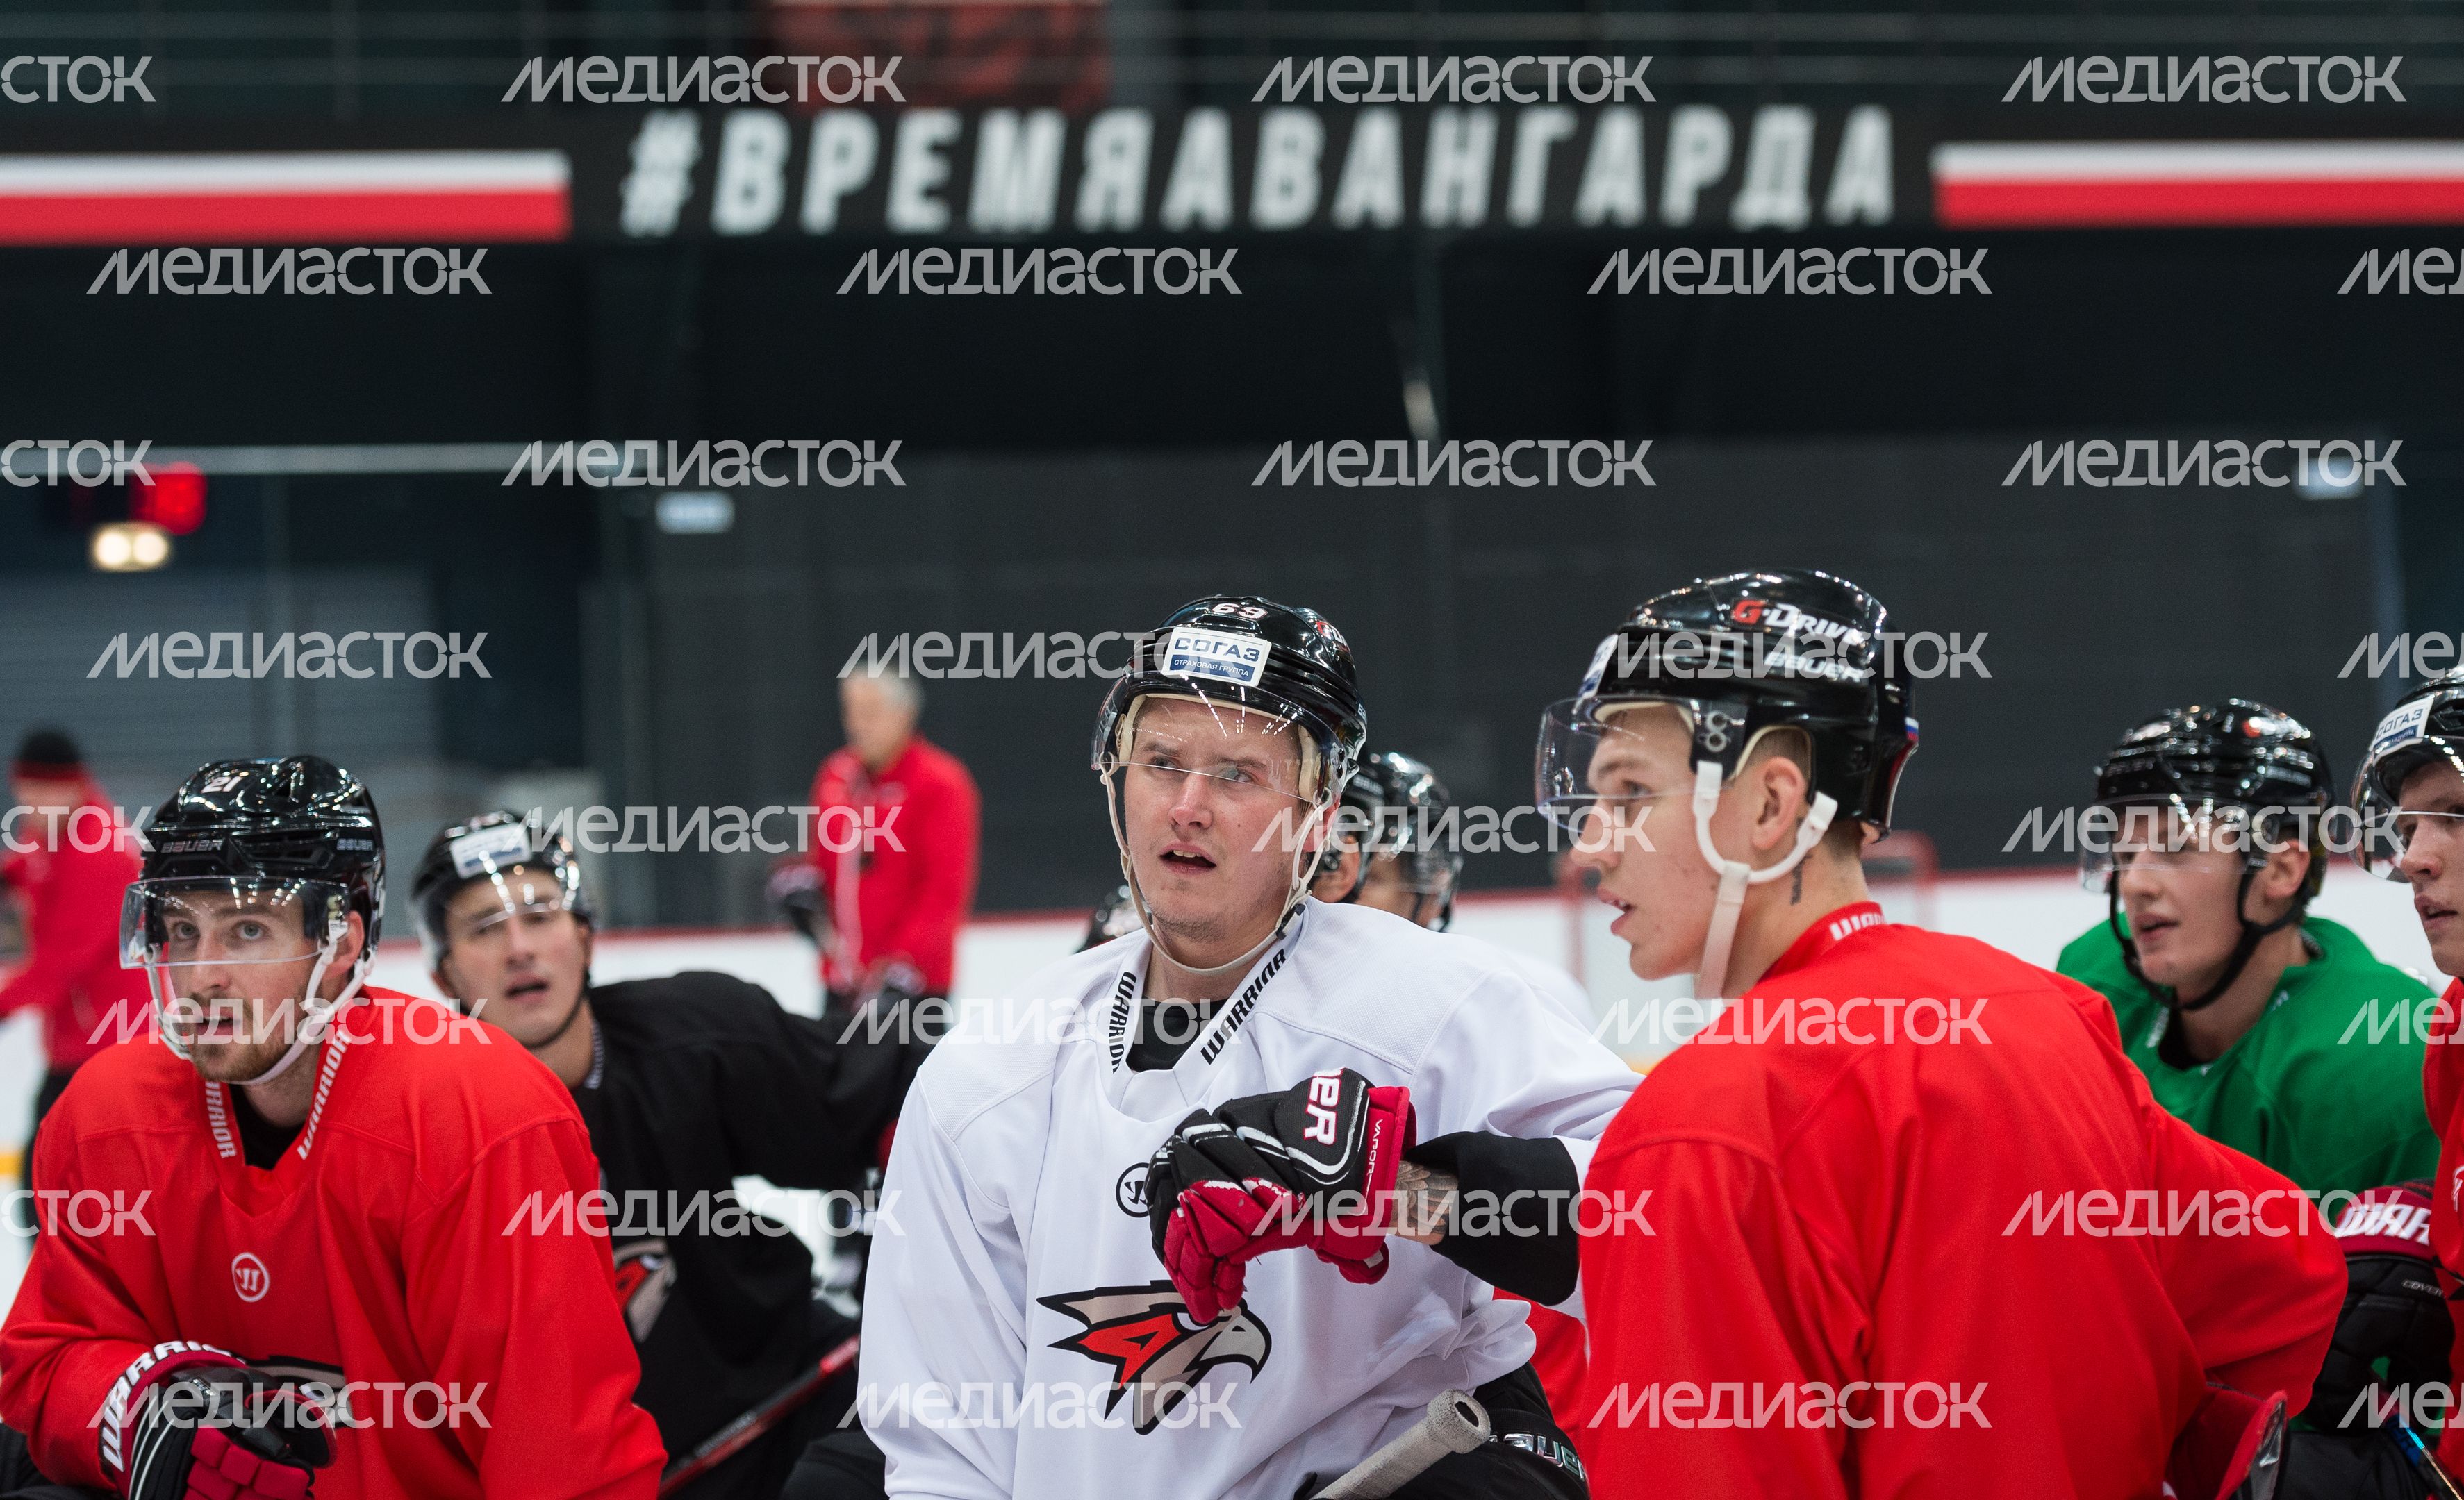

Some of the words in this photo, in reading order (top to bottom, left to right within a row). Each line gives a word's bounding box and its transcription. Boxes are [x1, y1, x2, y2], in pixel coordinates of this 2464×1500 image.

[619, 104, 1894, 238] #ВРЕМЯАВАНГАРДА
[1212, 603, 1268, 620] 69
[1175, 638, 1260, 662] СОГАЗ
[1174, 659, 1217, 670] СТРАХОВАЯ
[1219, 665, 1249, 677] ГРУППА
[2376, 708, 2424, 739] СОГАЗ
[201, 776, 243, 794] 21
[160, 838, 224, 854] BAUER
[1200, 948, 1287, 1065] WARRIOR
[102, 1340, 246, 1472] WARRI
